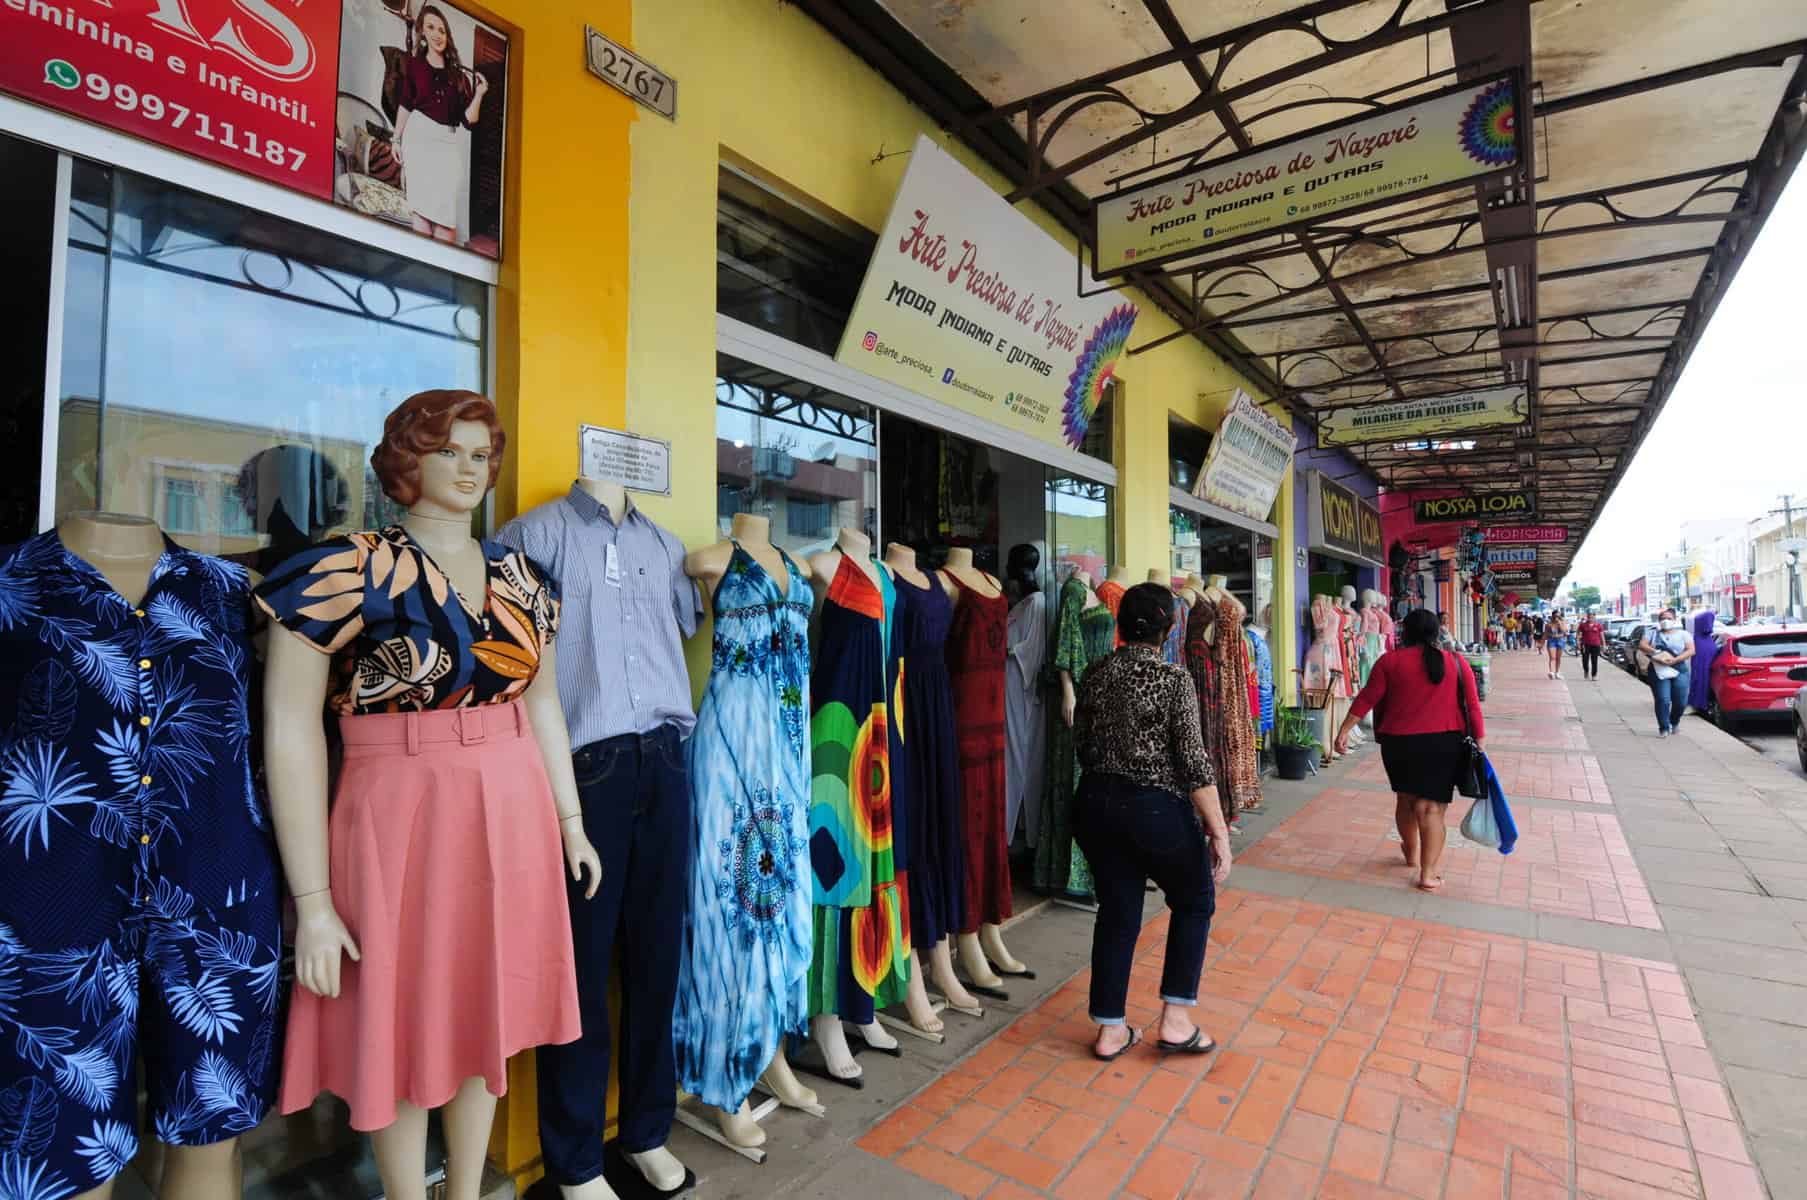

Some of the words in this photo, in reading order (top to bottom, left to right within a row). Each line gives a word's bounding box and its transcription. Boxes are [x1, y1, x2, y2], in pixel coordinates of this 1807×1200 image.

[166, 55, 186, 74] e
[199, 63, 316, 128] Infantil.
[603, 47, 664, 103] 2767
[86, 73, 307, 172] 999711187
[1127, 194, 1174, 222] Arte
[1182, 165, 1280, 206] Preciosa
[1288, 152, 1315, 174] de
[1324, 117, 1419, 163] Nazaré
[1283, 186, 1296, 196] E
[1304, 160, 1384, 192] OUTRAS
[899, 209, 947, 272] Arte
[947, 239, 1016, 315] Preciosa
[1015, 292, 1035, 326] de
[1033, 299, 1083, 352] Nazaré
[995, 338, 1007, 353] E
[1006, 345, 1053, 377] OUTRAS
[1352, 411, 1404, 426] MILAGRE
[1407, 408, 1423, 419] DA
[1426, 401, 1486, 417] FLORESTA
[1424, 498, 1477, 516] NOSSA
[1482, 495, 1526, 512] LOJA
